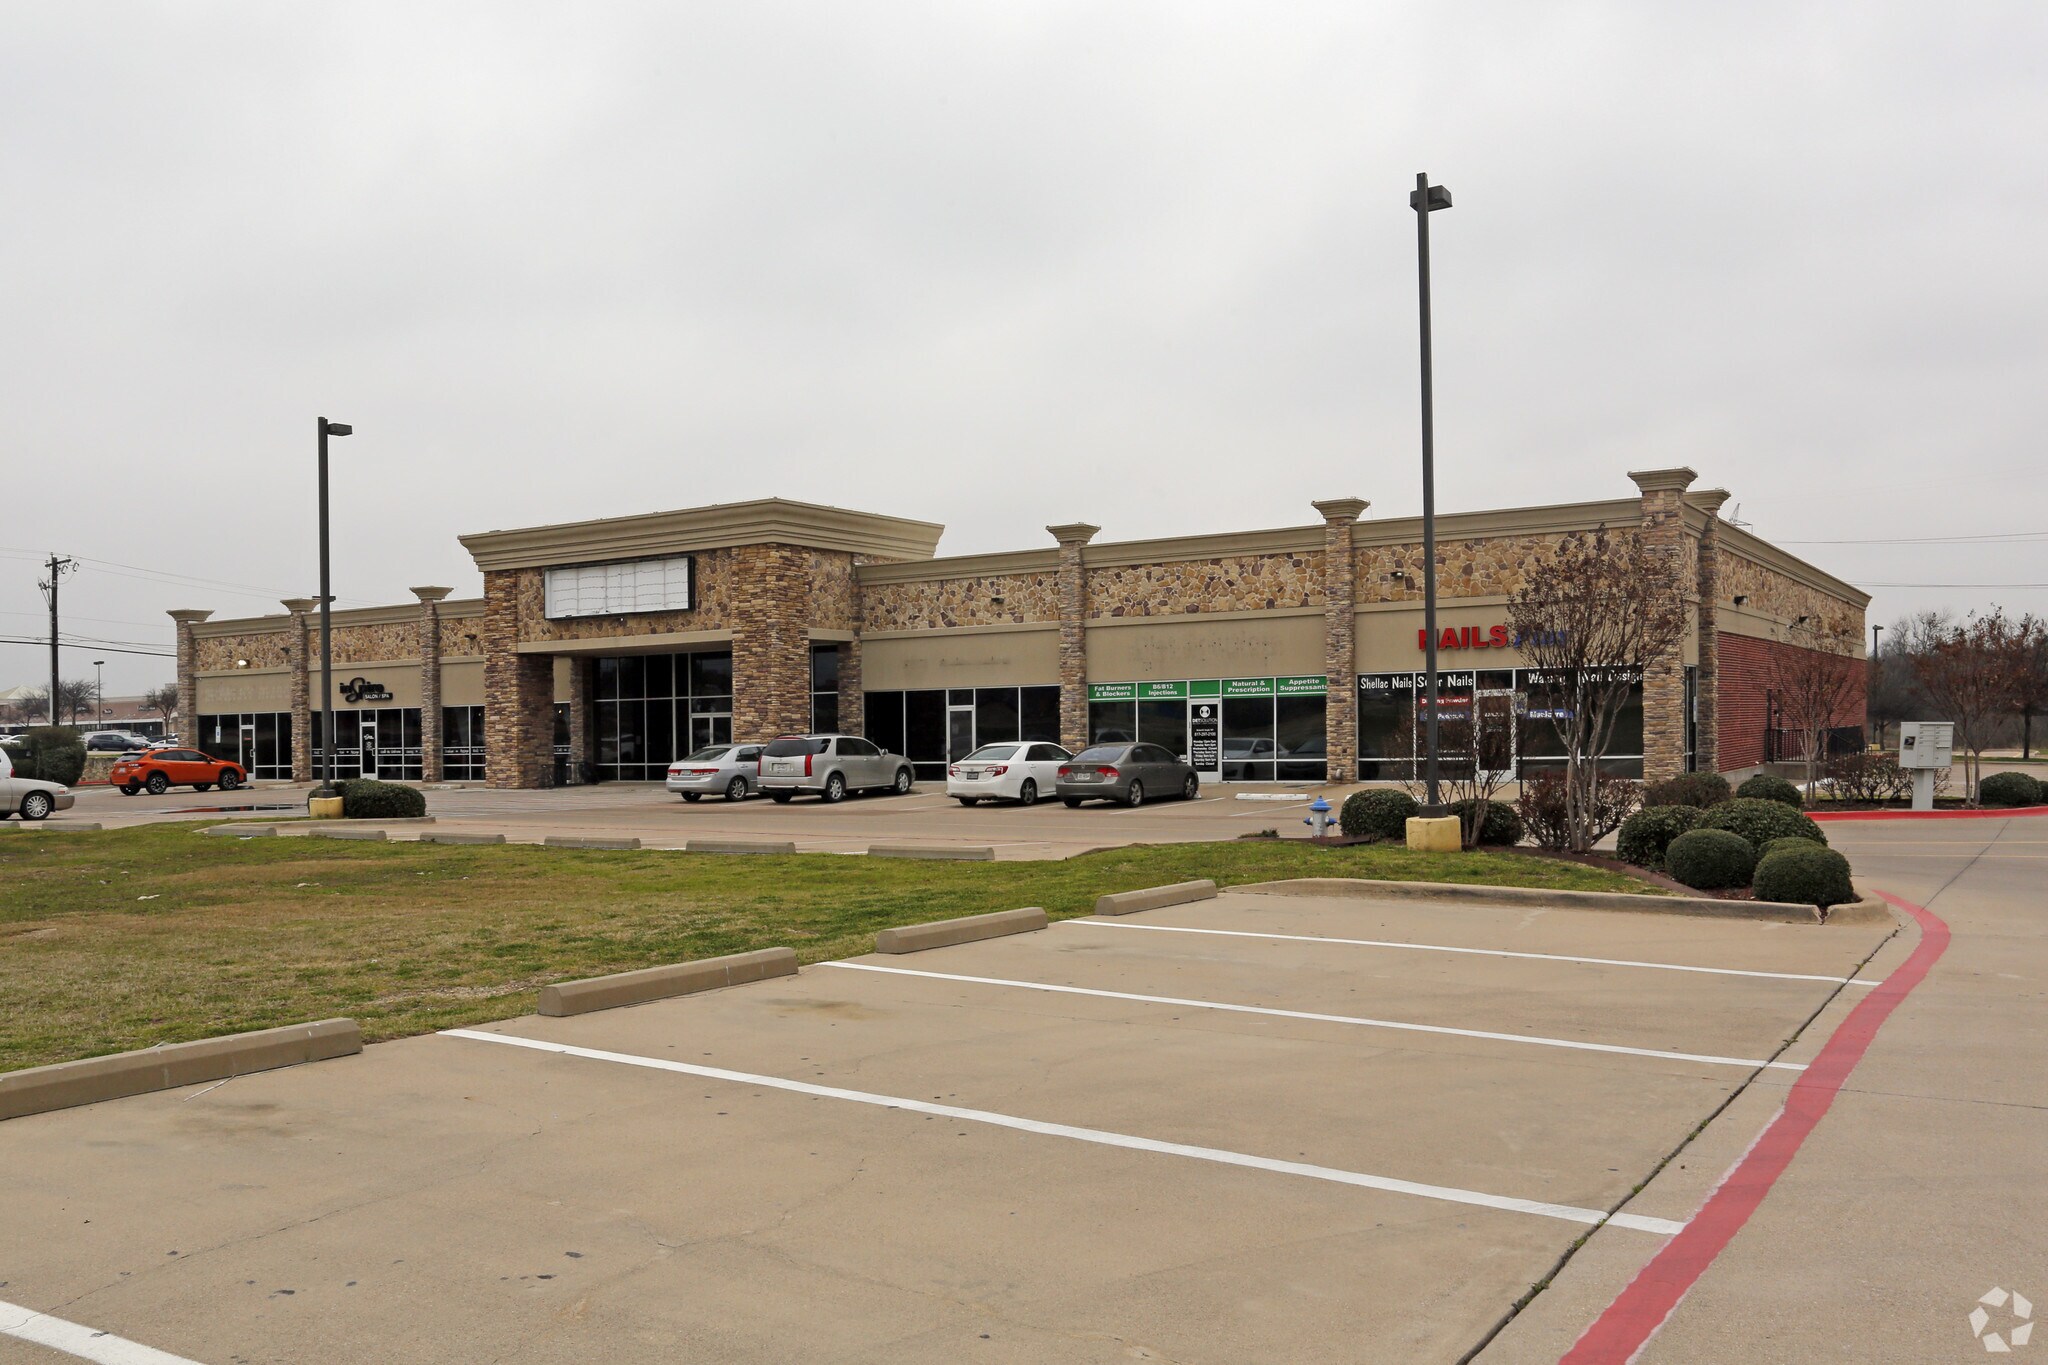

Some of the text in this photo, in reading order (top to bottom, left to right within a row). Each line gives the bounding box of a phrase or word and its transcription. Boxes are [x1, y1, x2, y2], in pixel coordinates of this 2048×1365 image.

[1360, 676, 1389, 690] Shellac
[1392, 675, 1413, 690] Nails
[1447, 674, 1474, 688] Nails
[1227, 686, 1271, 694] Prescription
